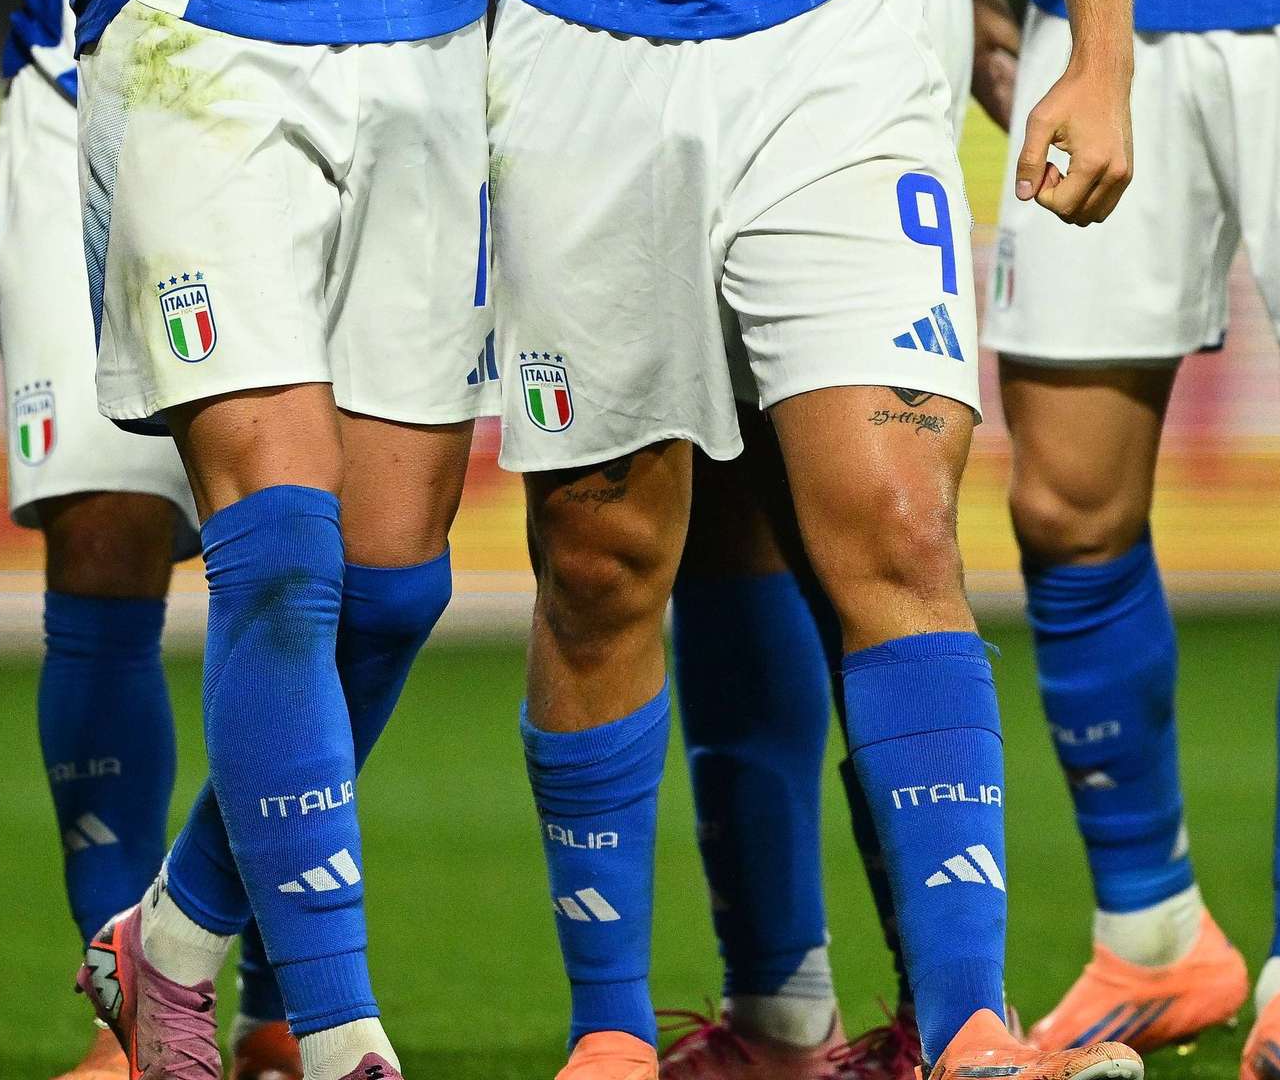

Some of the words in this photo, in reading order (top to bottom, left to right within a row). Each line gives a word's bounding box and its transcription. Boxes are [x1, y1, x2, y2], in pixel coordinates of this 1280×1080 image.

[895, 172, 958, 296] 9
[164, 290, 206, 312] ITALIA
[524, 368, 564, 383] ITALIA
[260, 780, 355, 818] ITALIA
[891, 782, 1002, 810] ITALIA
[546, 823, 619, 850] ALIA
